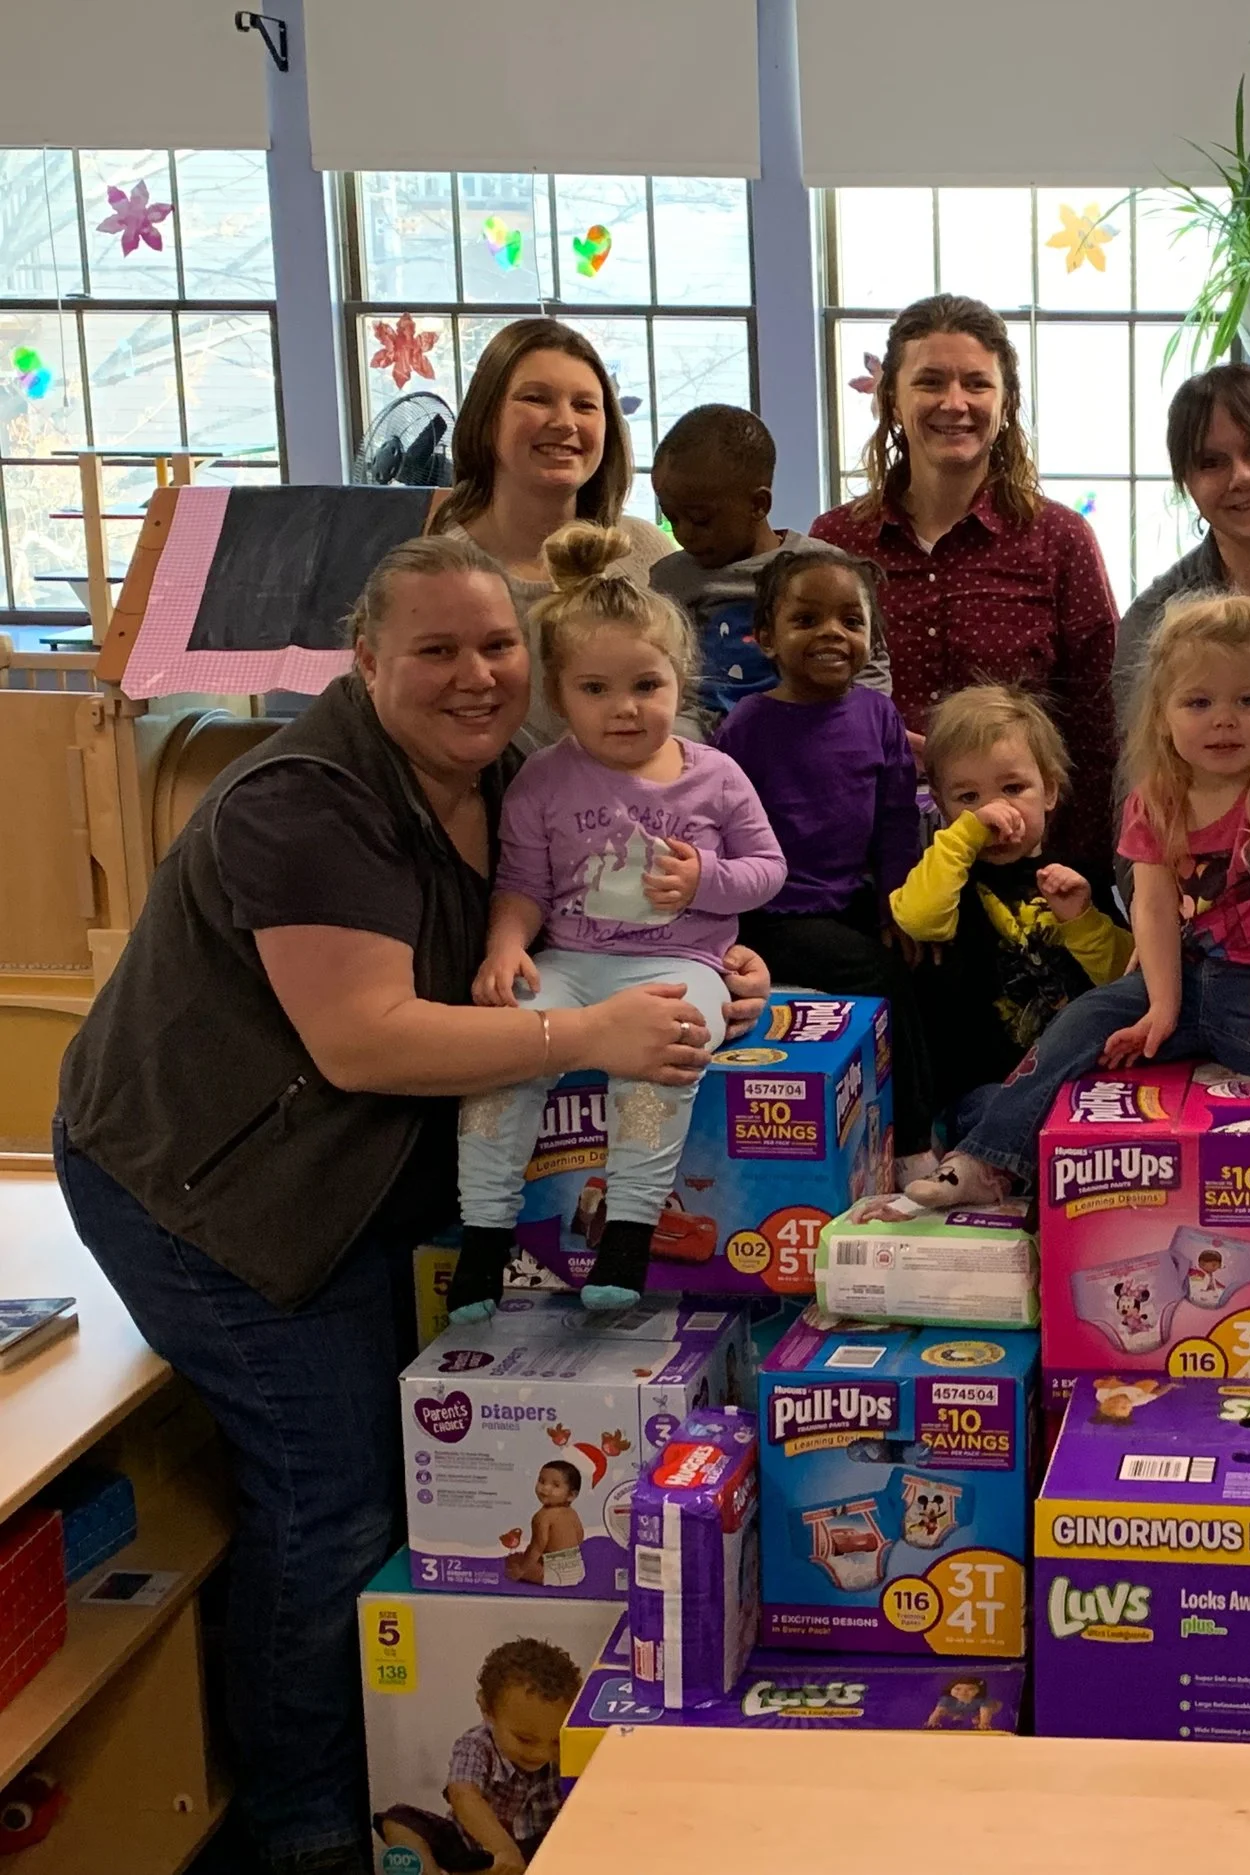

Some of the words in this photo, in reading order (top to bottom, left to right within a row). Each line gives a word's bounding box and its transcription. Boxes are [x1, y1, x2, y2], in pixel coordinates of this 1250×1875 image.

[575, 806, 612, 833] ICE
[627, 805, 698, 842] CASTLE
[745, 1083, 802, 1096] 4574704
[749, 1100, 791, 1125] $10
[578, 1134, 605, 1145] PANTS
[735, 1124, 818, 1141] SAVINGS
[536, 1154, 586, 1172] Learning
[1074, 1197, 1116, 1213] Learning
[1118, 1193, 1159, 1207] Designs
[952, 1212, 969, 1224] 5
[776, 1219, 822, 1247] 4T
[731, 1241, 767, 1258] 102
[779, 1247, 817, 1275] 5T
[1178, 1352, 1216, 1373] 116
[933, 1387, 994, 1401] 4574504
[422, 1400, 469, 1423] Parent's
[480, 1403, 558, 1422] Diapers
[937, 1407, 982, 1434] $10
[433, 1419, 465, 1434] CHOICE
[793, 1437, 835, 1451] Learning
[920, 1432, 1010, 1451] SAVINGS
[664, 1445, 715, 1487] HUGGIES
[1053, 1515, 1244, 1551] GINORMOUS
[421, 1558, 439, 1582] 3
[447, 1559, 462, 1570] 72
[947, 1562, 1006, 1599] 3T
[893, 1590, 930, 1611] 116
[1180, 1588, 1226, 1611] Locks
[378, 1611, 398, 1619] SIZE
[772, 1614, 778, 1623] 2
[780, 1614, 830, 1626] EXCITING
[832, 1616, 879, 1628] DESIGNS
[946, 1600, 1006, 1636] 4T
[377, 1620, 400, 1647] 5
[376, 1665, 408, 1680] 138
[618, 1682, 633, 1694] 4
